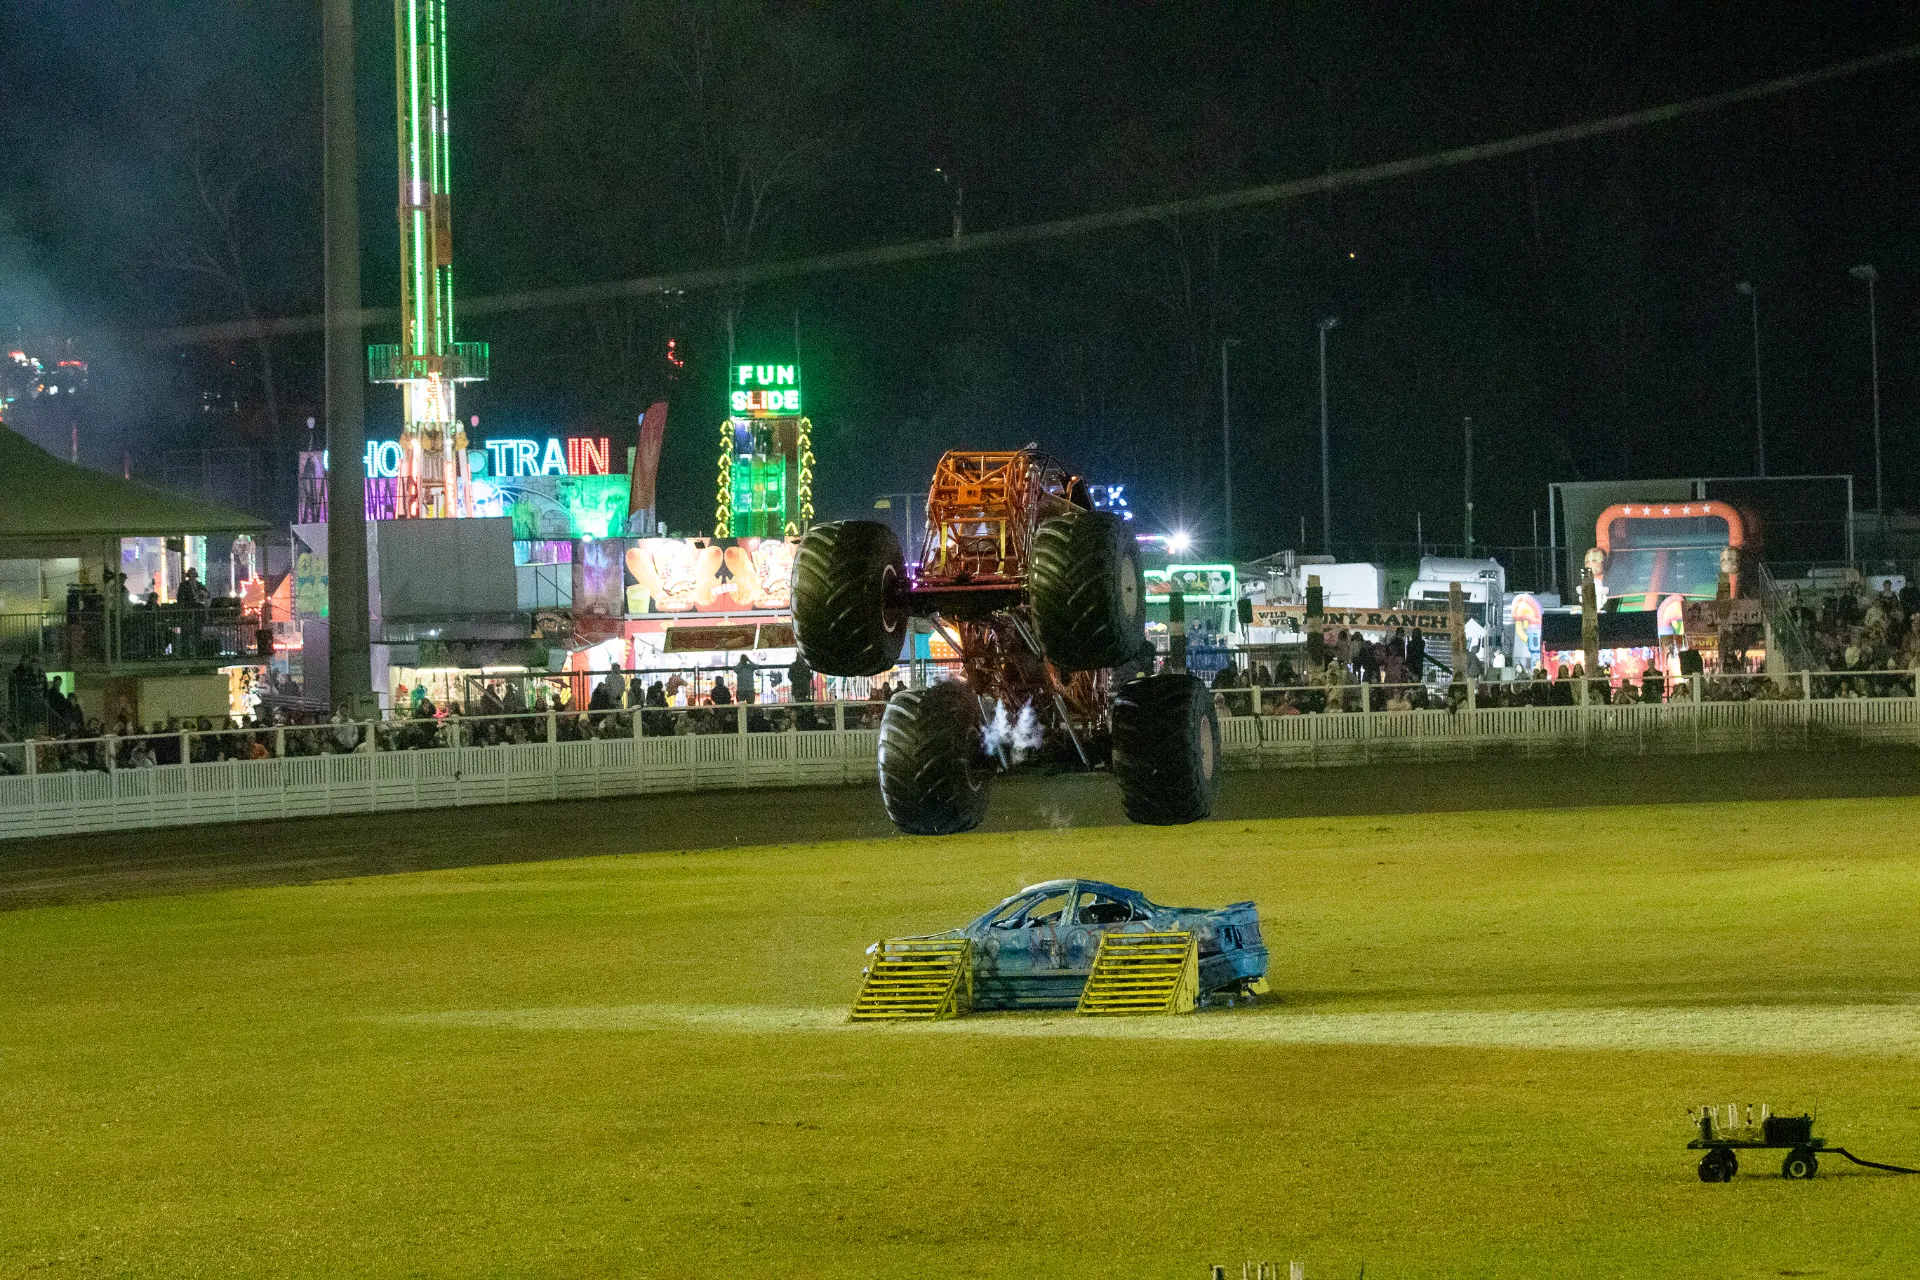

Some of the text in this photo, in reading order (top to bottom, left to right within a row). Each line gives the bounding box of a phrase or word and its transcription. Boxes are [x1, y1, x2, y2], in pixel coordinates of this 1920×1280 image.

[739, 365, 794, 385] FUN
[731, 390, 799, 411] SLIDE
[485, 438, 610, 476] TRAIN
[1258, 611, 1287, 619] WILD
[1366, 613, 1448, 628] RANCH
